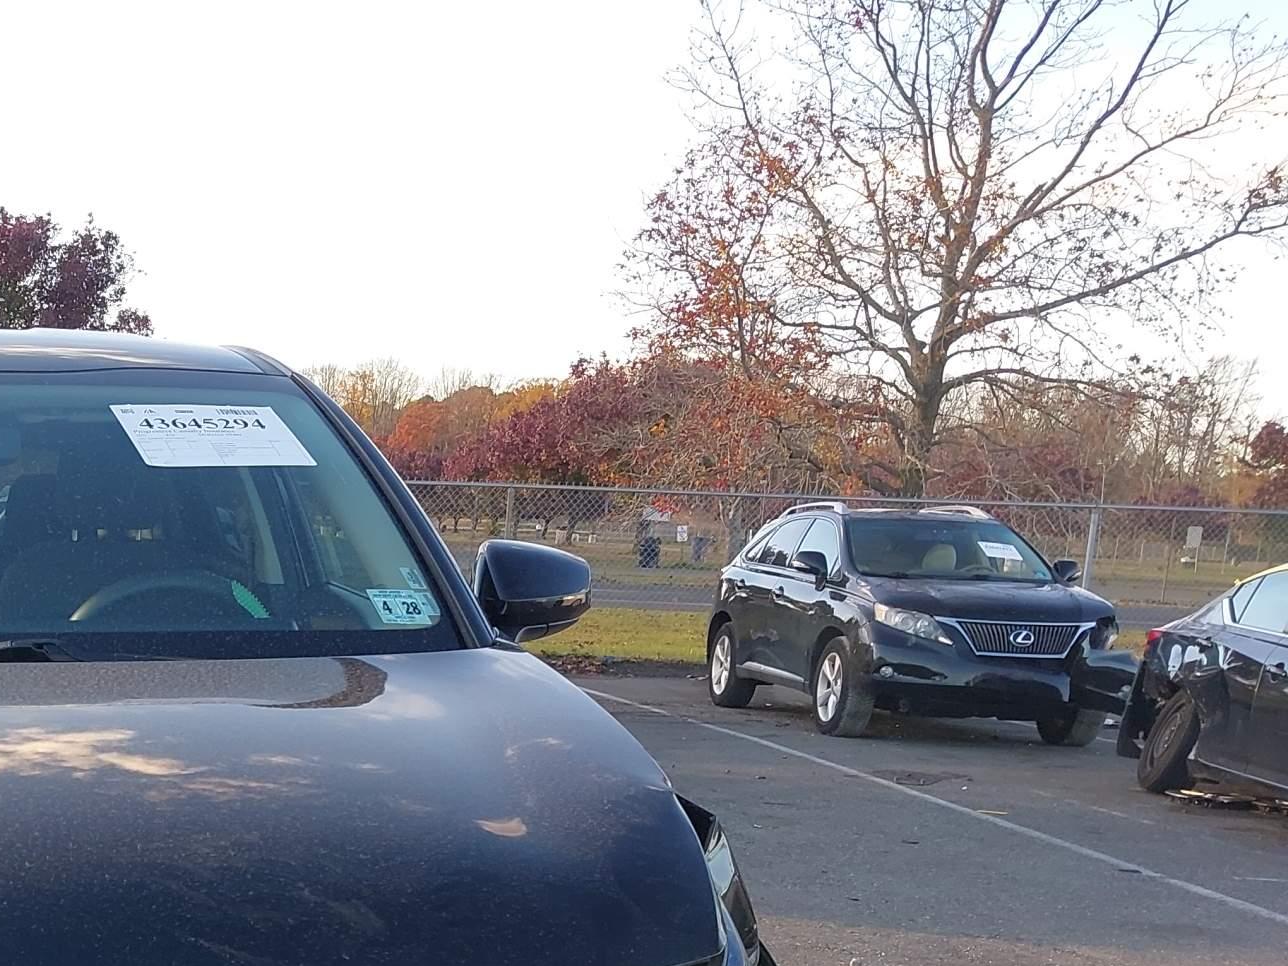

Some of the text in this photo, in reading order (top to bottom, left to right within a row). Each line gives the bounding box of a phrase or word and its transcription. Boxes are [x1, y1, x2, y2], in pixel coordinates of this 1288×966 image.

[139, 418, 266, 430] 43645294
[382, 600, 393, 615] 4
[401, 601, 422, 615] 28
